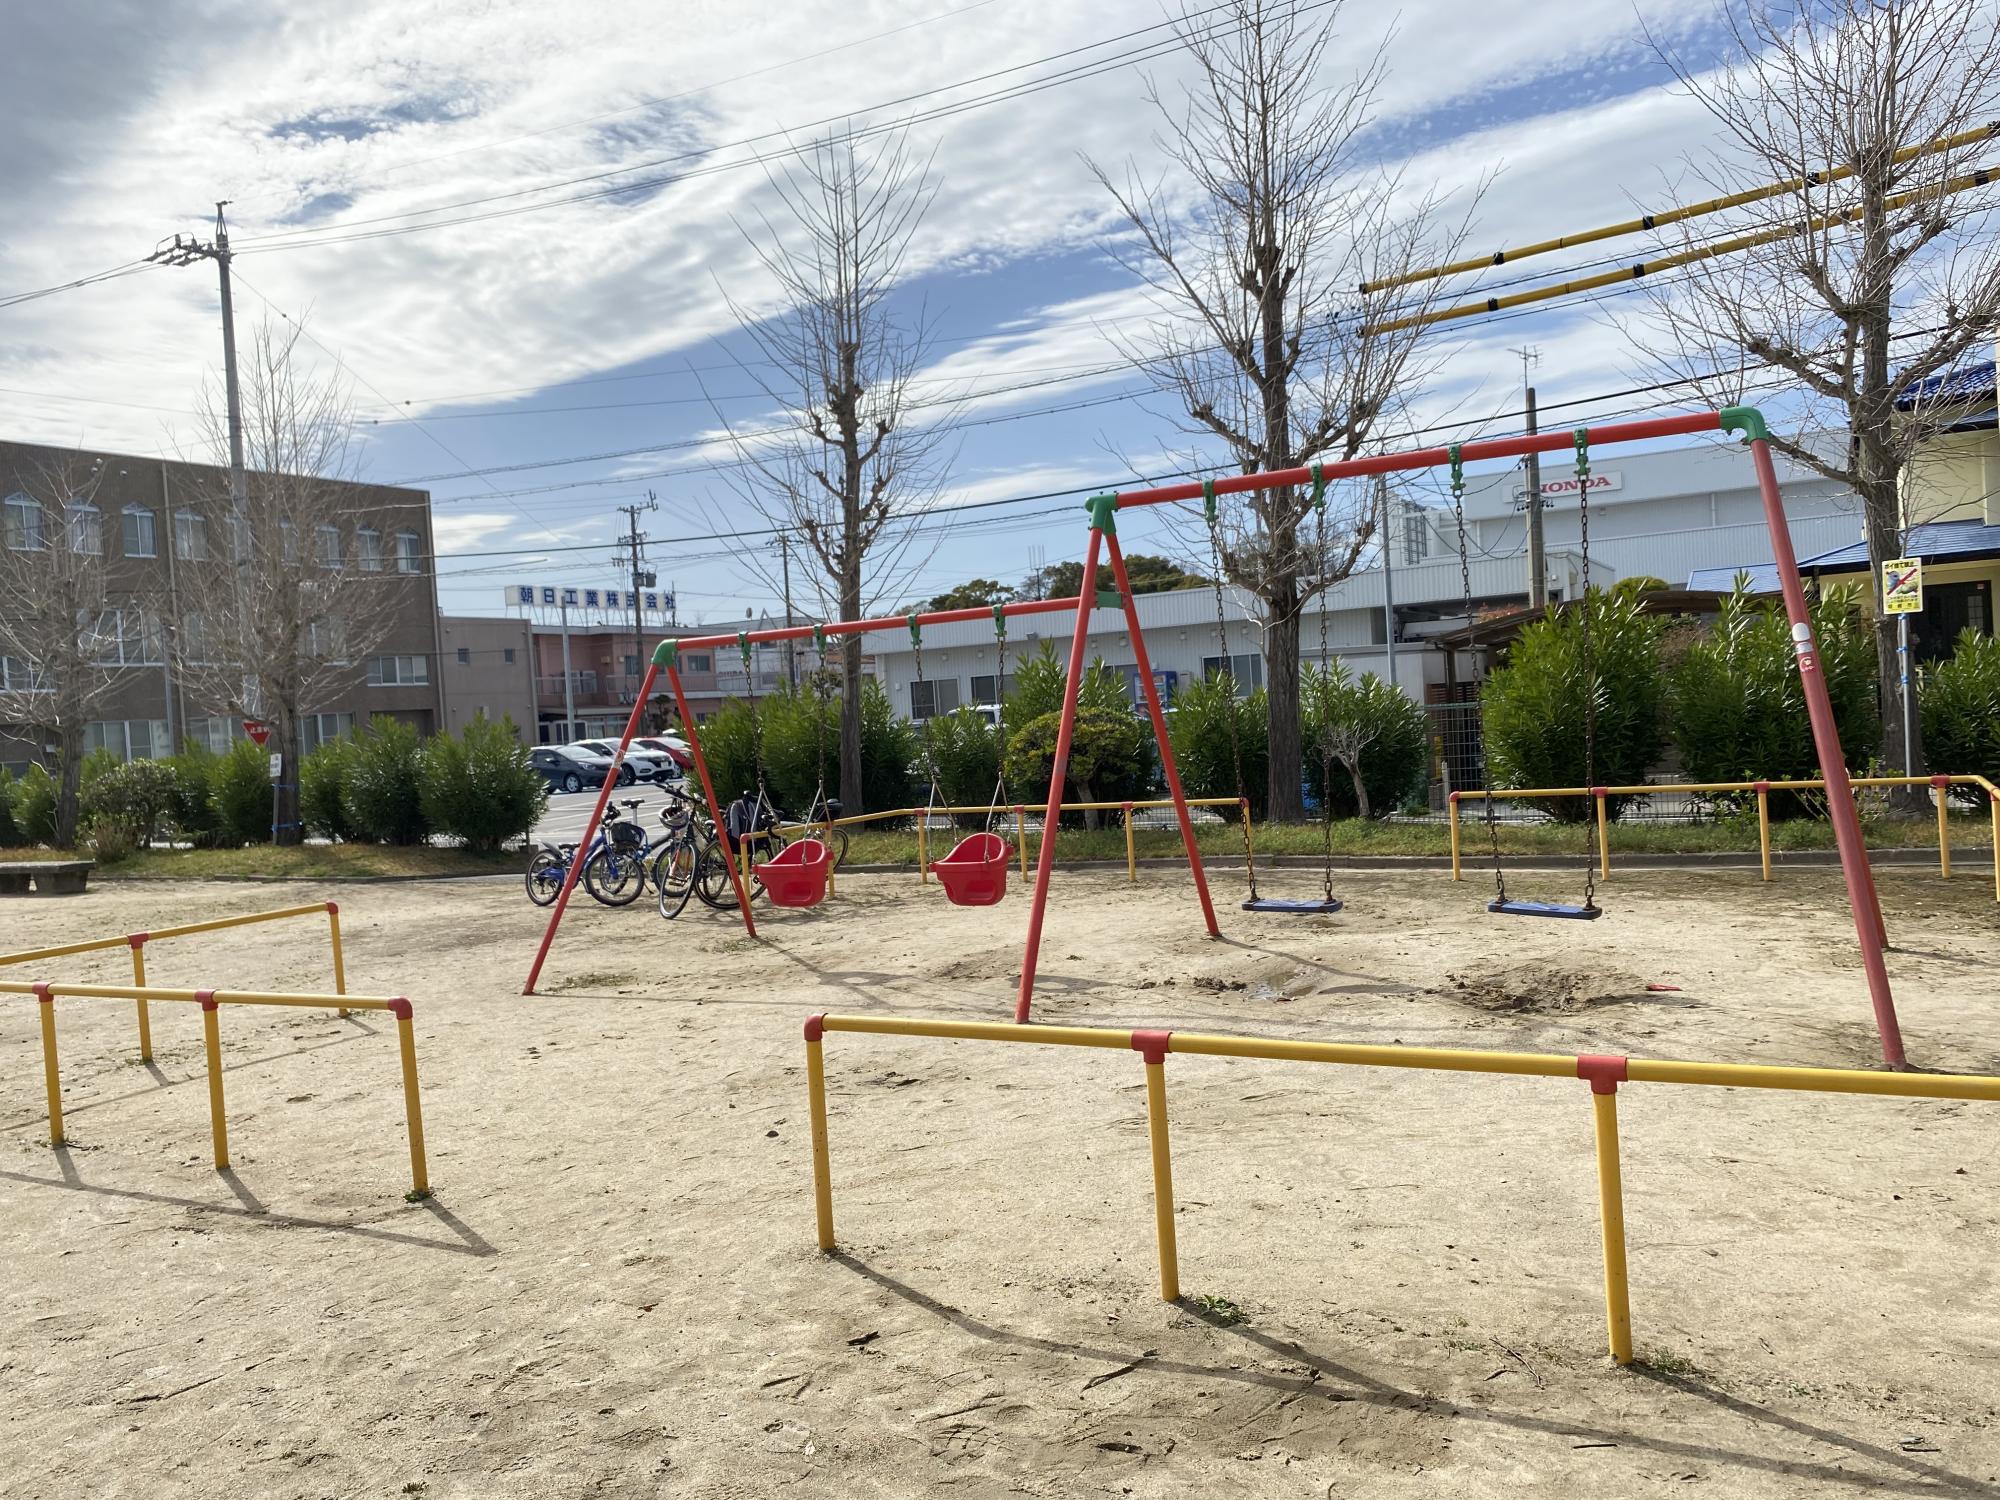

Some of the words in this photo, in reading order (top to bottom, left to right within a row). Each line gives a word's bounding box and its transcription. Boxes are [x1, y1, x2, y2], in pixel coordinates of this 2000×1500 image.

[521, 587, 675, 609] 朝日工業株式会社
